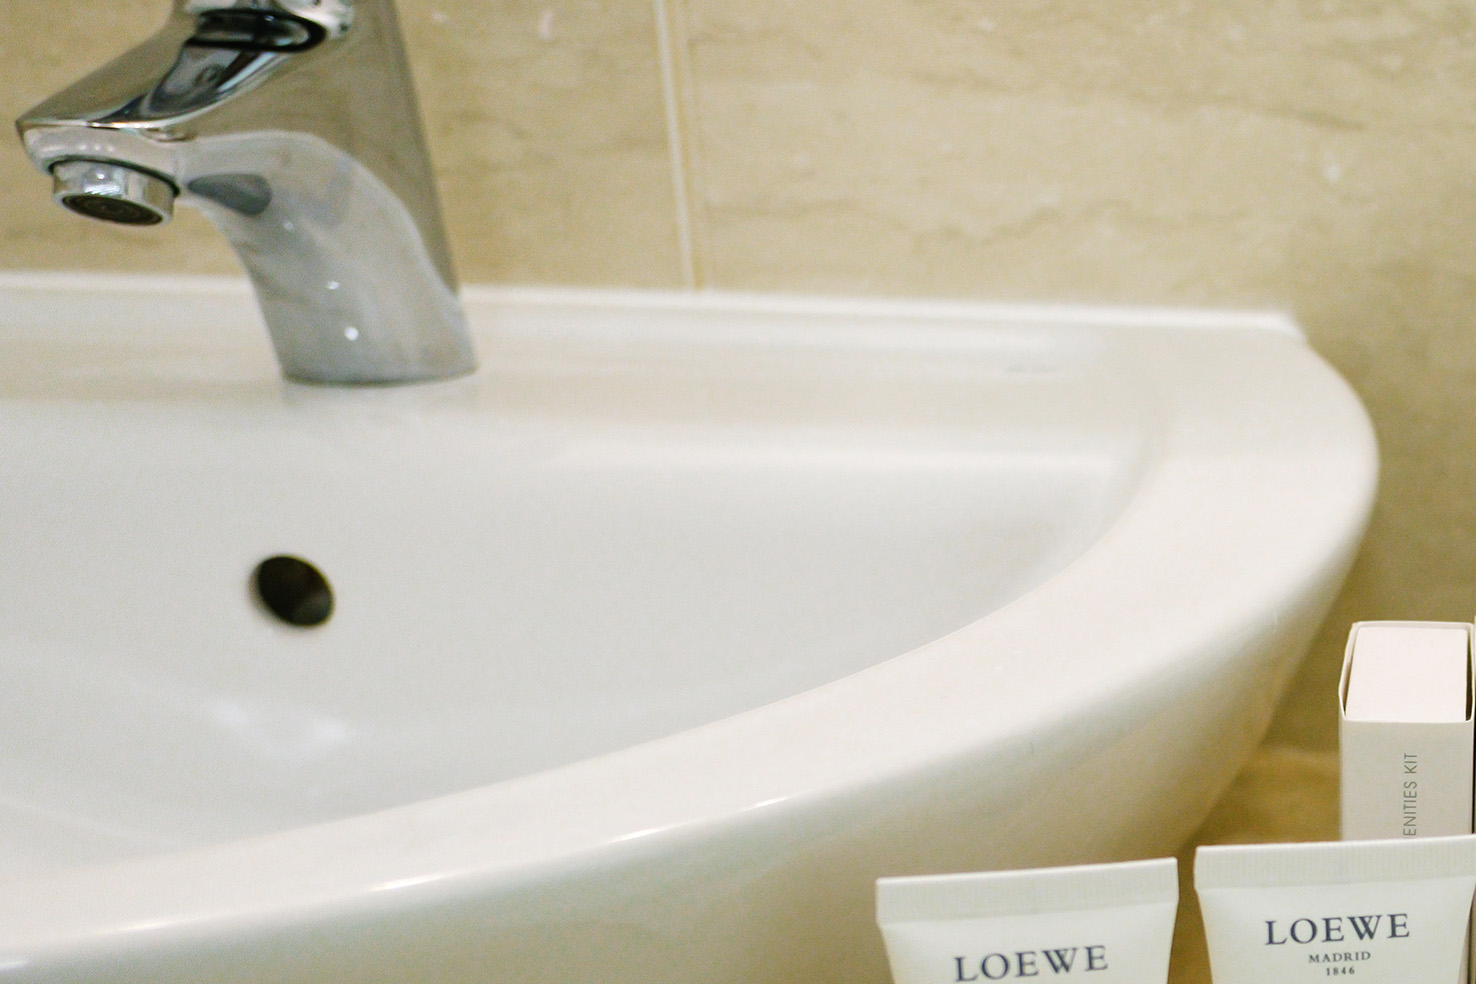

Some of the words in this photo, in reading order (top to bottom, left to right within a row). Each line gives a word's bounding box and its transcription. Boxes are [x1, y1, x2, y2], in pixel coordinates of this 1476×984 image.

[1403, 753, 1418, 774] KIT
[1403, 781, 1418, 836] ENITIES
[1265, 913, 1410, 945] LOEWE
[954, 945, 1109, 982] LOEWE
[1308, 951, 1371, 963] MADRID
[1326, 966, 1355, 976] 1846
